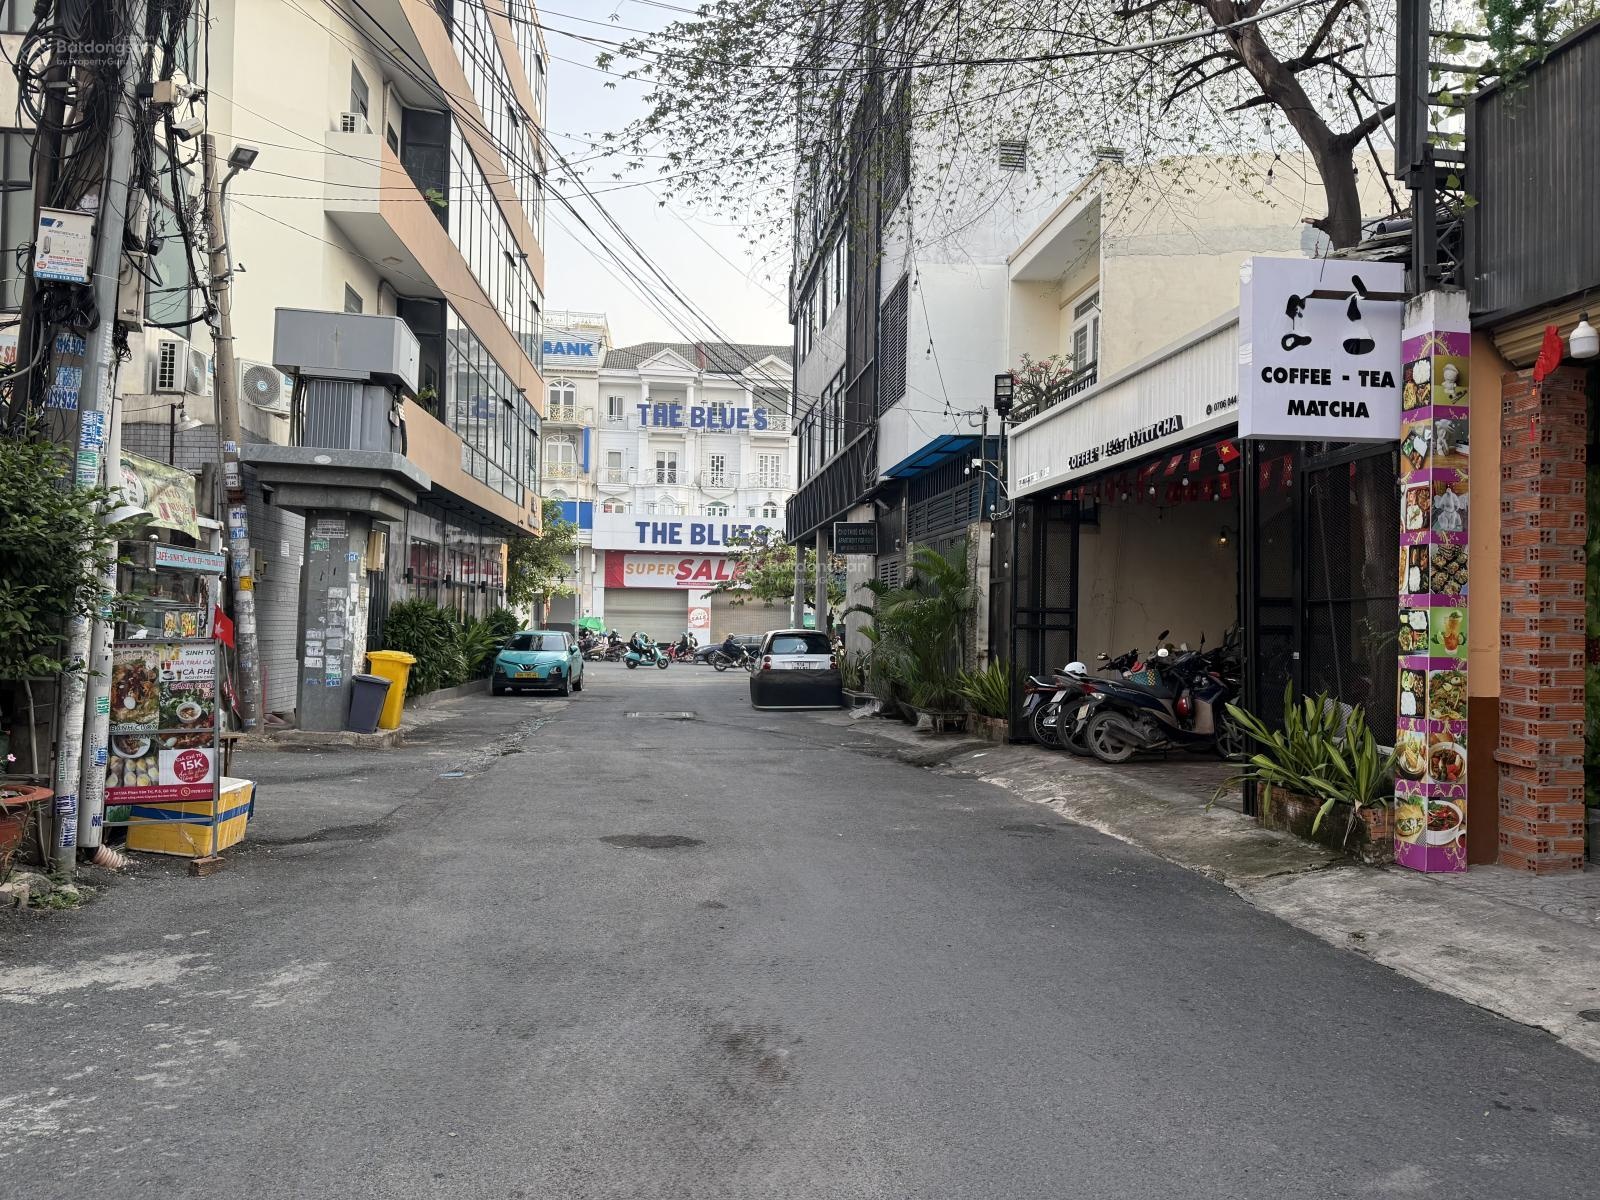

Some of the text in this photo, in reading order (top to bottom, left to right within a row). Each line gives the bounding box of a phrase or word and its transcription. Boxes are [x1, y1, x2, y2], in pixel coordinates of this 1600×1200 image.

[1261, 366, 1332, 386] COFFEE
[1358, 370, 1396, 388] TEA
[637, 403, 768, 431] THE BLUES
[1287, 400, 1370, 418] MATCHA
[635, 522, 683, 545] THE
[625, 561, 676, 576] SUPER
[181, 758, 204, 771] 15K
